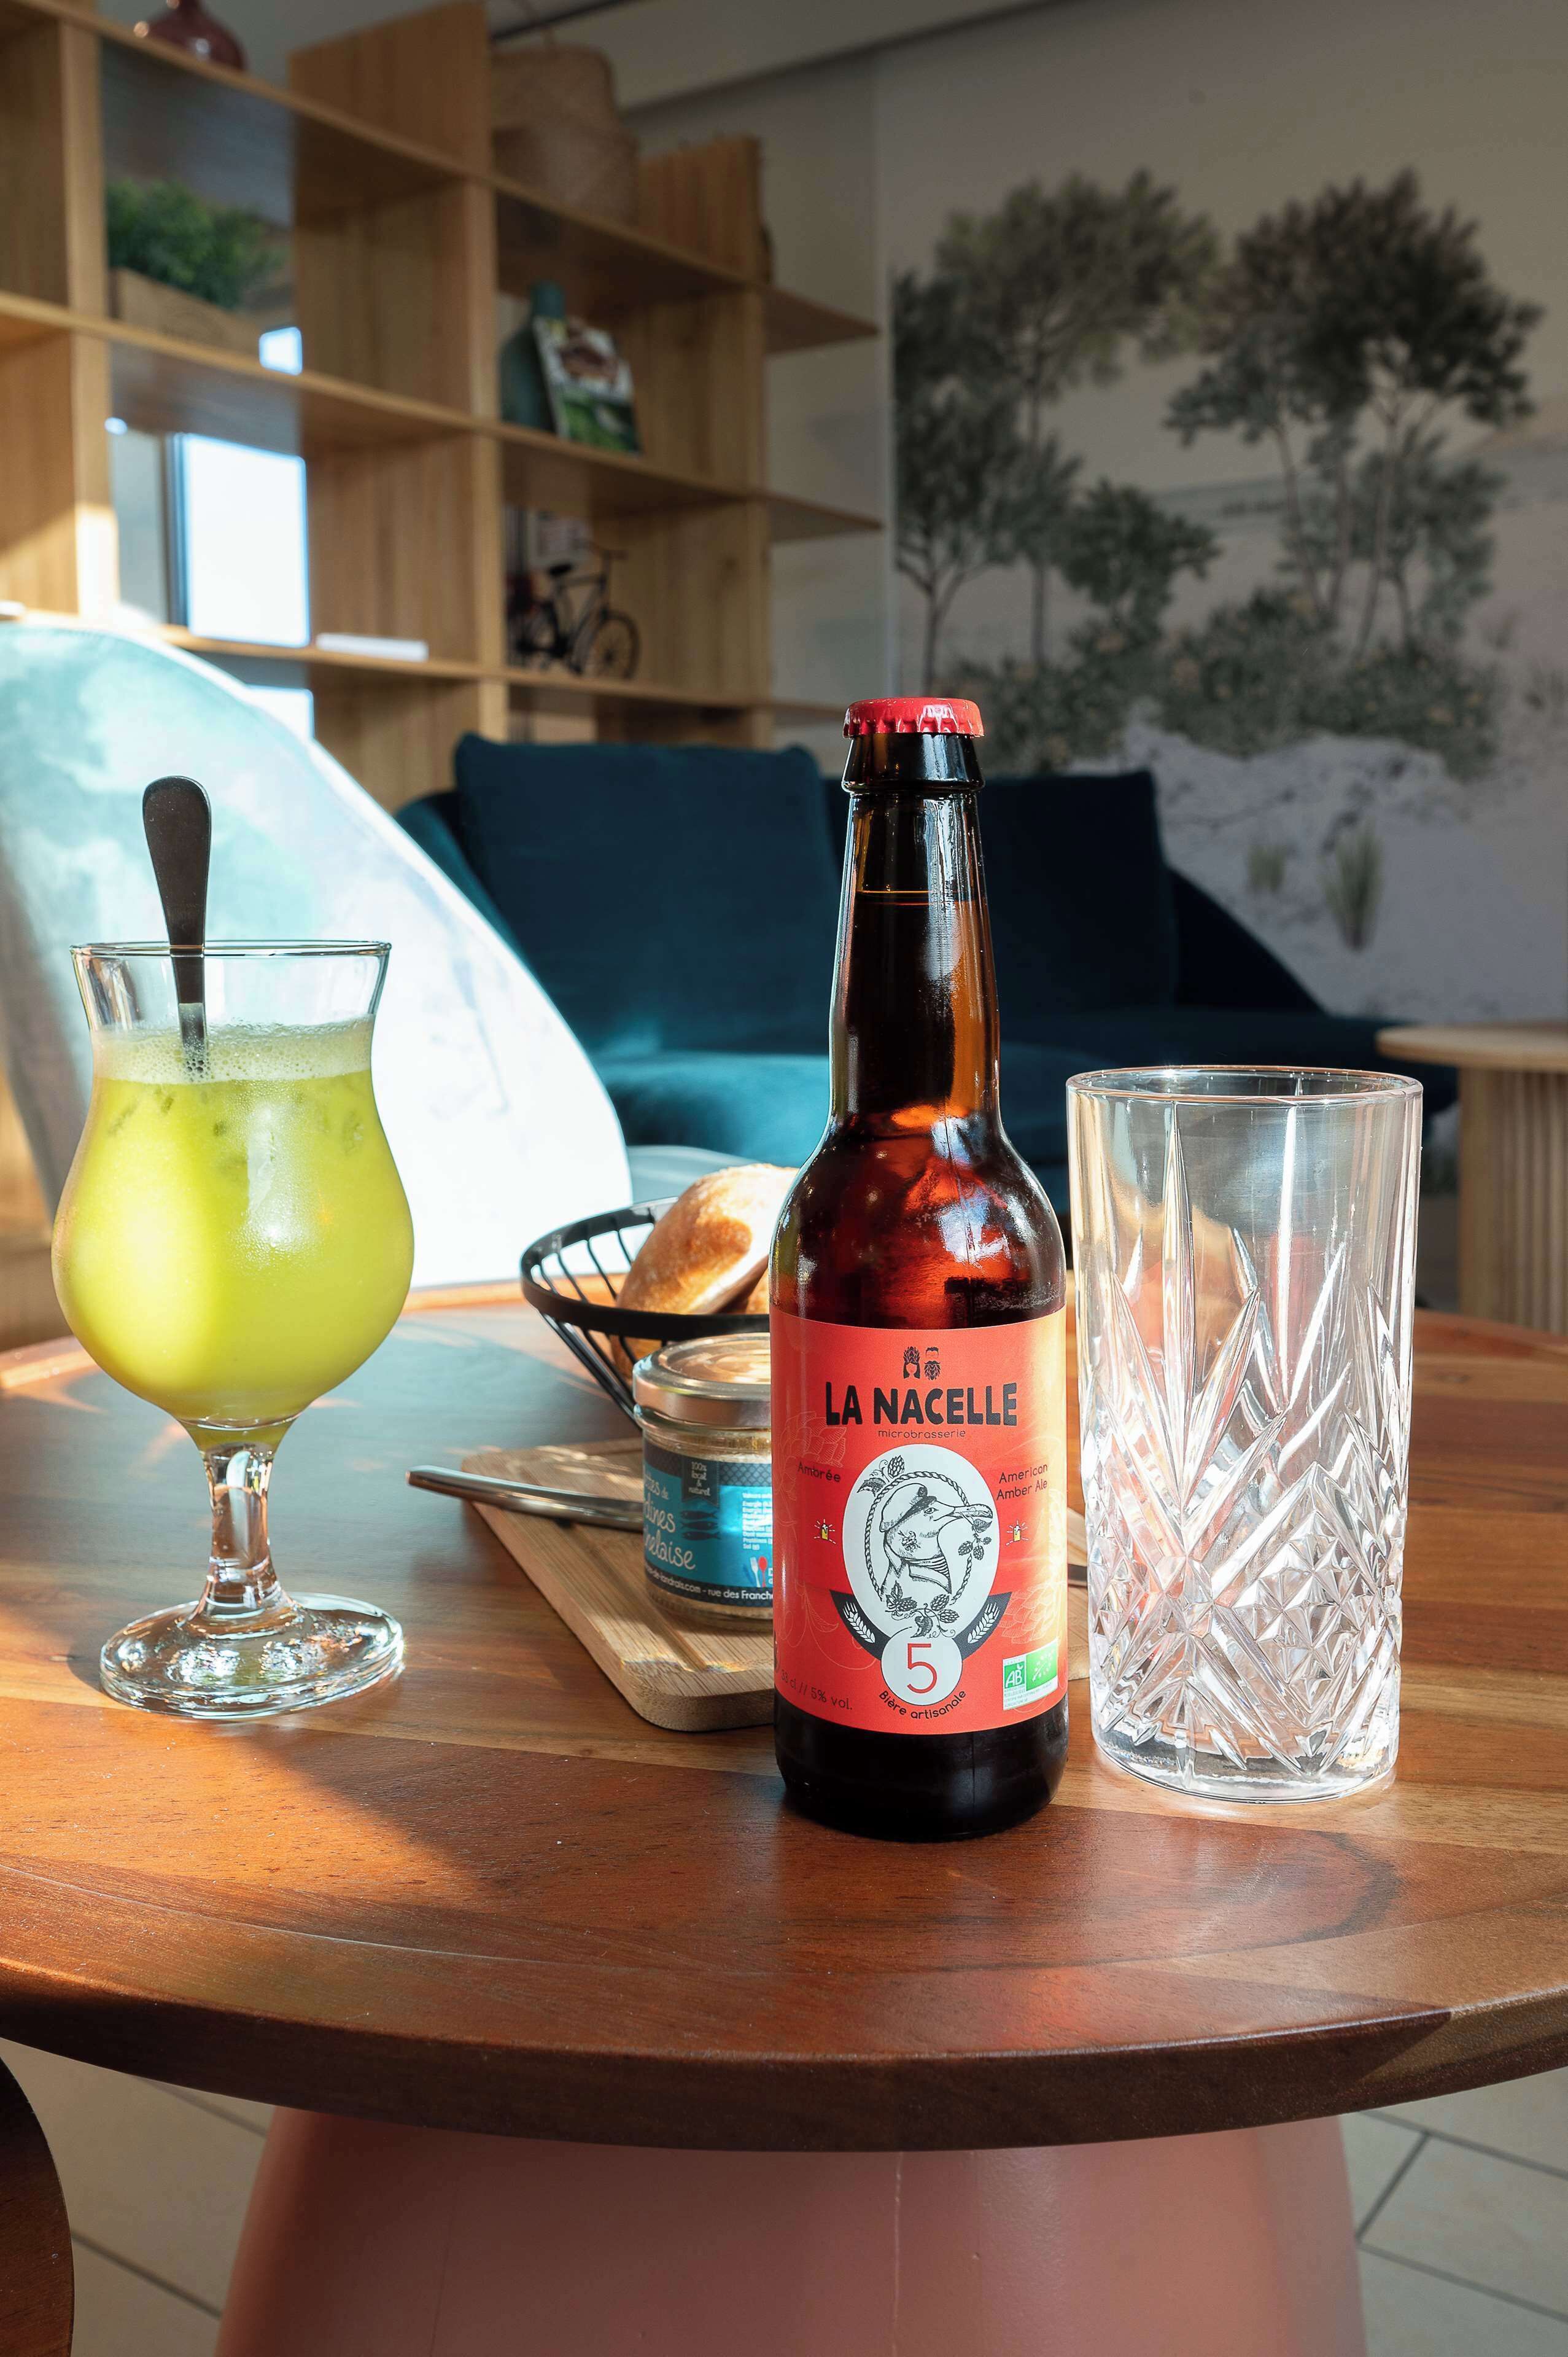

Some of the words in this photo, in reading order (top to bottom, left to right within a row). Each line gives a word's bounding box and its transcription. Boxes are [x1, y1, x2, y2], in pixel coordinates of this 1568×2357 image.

[826, 1382, 863, 1425] LA
[874, 1382, 1017, 1426] NACELLE
[878, 1428, 966, 1439] microbrasserie
[798, 1461, 841, 1482] Ambrée
[998, 1464, 1048, 1484] American
[996, 1486, 1033, 1501] Amber
[1035, 1478, 1048, 1492] Ale
[708, 1589, 721, 1597] rue
[723, 1589, 739, 1599] des
[906, 1643, 937, 1694] 5
[1006, 1669, 1023, 1688] AB
[811, 1686, 827, 1703] 5%
[831, 1696, 852, 1710] vol.
[879, 1690, 907, 1715] Bière
[910, 1690, 966, 1719] artisanale
